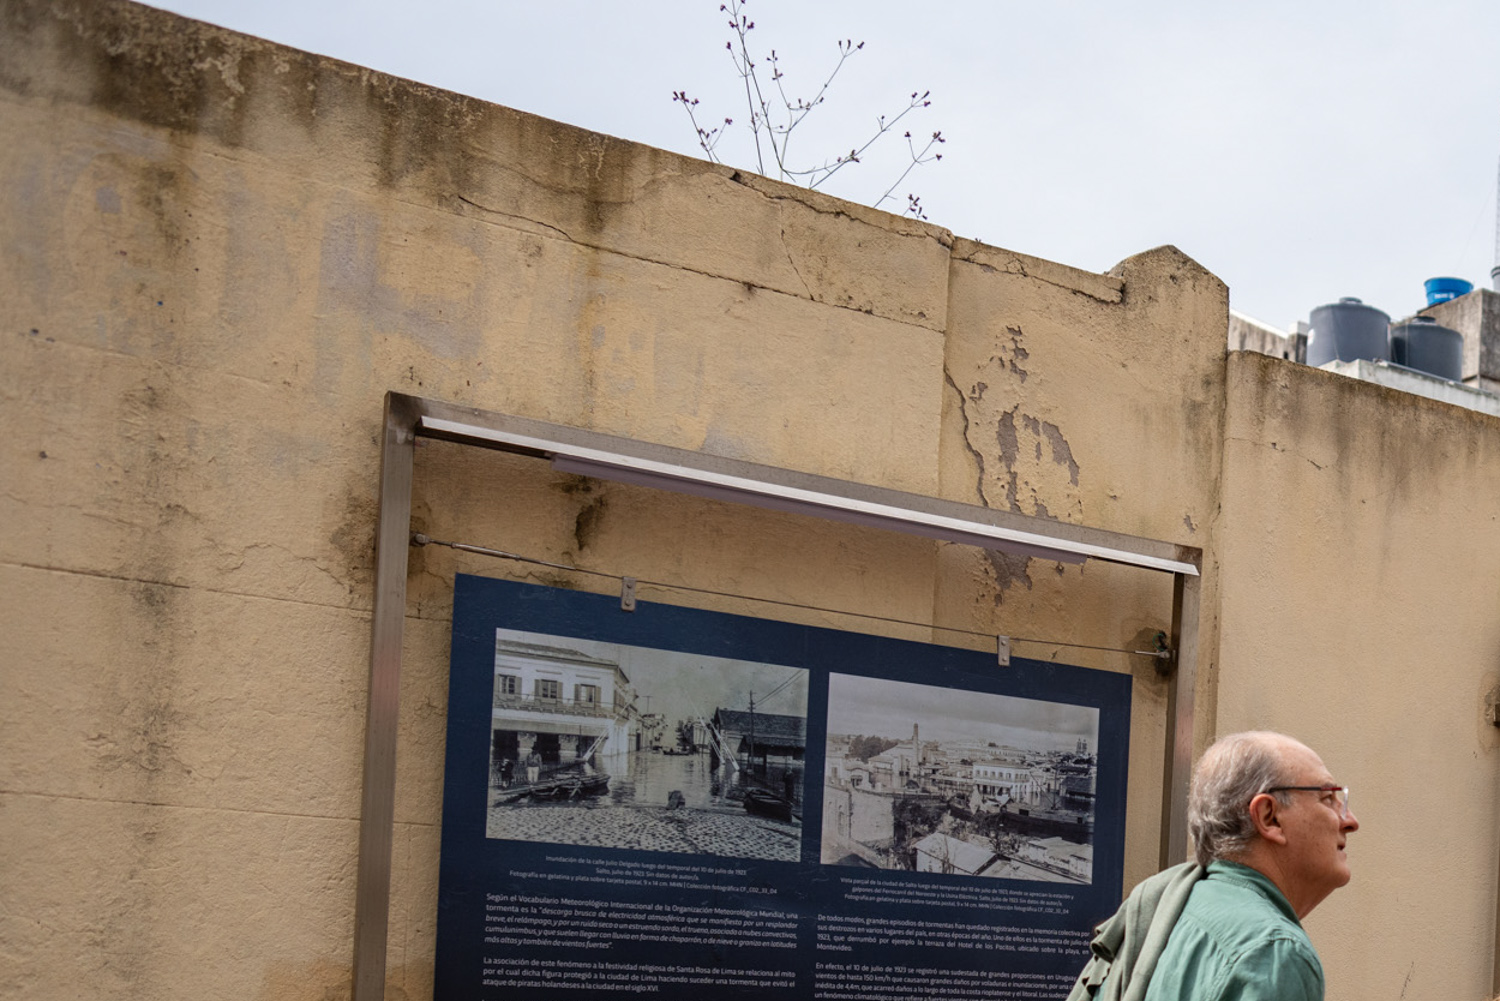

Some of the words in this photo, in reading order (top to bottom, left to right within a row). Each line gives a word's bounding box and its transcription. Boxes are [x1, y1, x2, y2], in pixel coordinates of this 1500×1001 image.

[493, 958, 530, 966] asociación
[557, 960, 592, 969] fenómeno
[605, 962, 638, 971] festividad
[638, 964, 666, 973] religiosa
[695, 966, 711, 974] Rosa
[745, 969, 774, 977] relaciona
[483, 968, 496, 976] por
[522, 969, 541, 977] dicha
[542, 969, 562, 979] figura
[563, 972, 592, 980] protegió
[607, 973, 630, 981] ciudad
[641, 974, 657, 982] Lima
[658, 975, 688, 983] haciendo
[482, 979, 508, 987] ataque
[517, 980, 542, 988] piratas
[542, 980, 581, 989] holandeses
[631, 984, 647, 993] siglo
